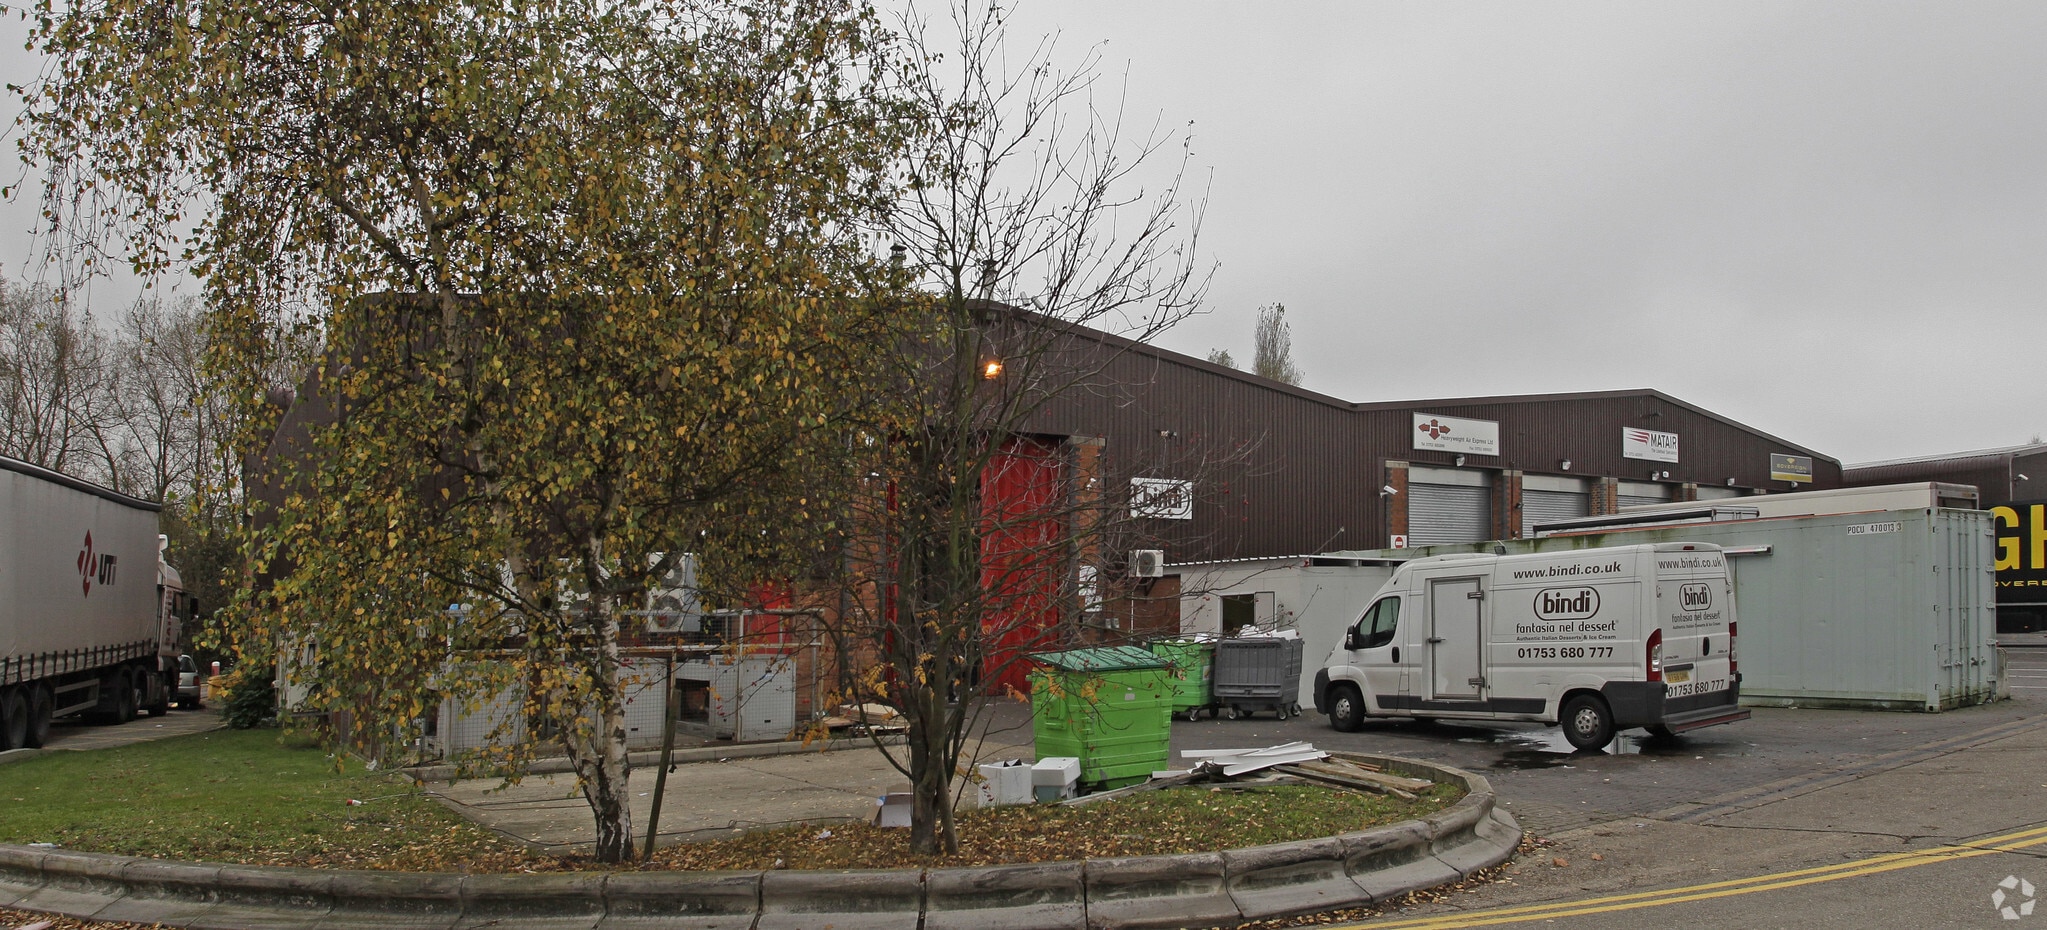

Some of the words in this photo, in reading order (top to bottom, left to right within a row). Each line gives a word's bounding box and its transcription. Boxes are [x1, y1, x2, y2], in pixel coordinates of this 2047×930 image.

[1650, 434, 1676, 449] MATAIR
[1870, 524, 1895, 532] 470013
[1896, 522, 1902, 531] 3
[1658, 557, 1722, 568] www.bindi.co.uk
[1514, 561, 1621, 579] www.bindi.co.uk
[1543, 590, 1590, 614] bindi
[1684, 586, 1708, 606] bindi
[1672, 612, 1693, 623] fantasia
[1694, 612, 1702, 621] nel
[1703, 610, 1720, 620] dessert
[1516, 622, 1555, 634] fantasia
[1559, 621, 1574, 632] nel
[1578, 620, 1616, 632] dessert
[1518, 648, 1556, 658] 01753
[1560, 648, 1584, 658] 680
[1589, 646, 1614, 658] 777
[1668, 684, 1692, 698] 01753
[1695, 682, 1708, 694] 680
[1711, 679, 1724, 690] 777
